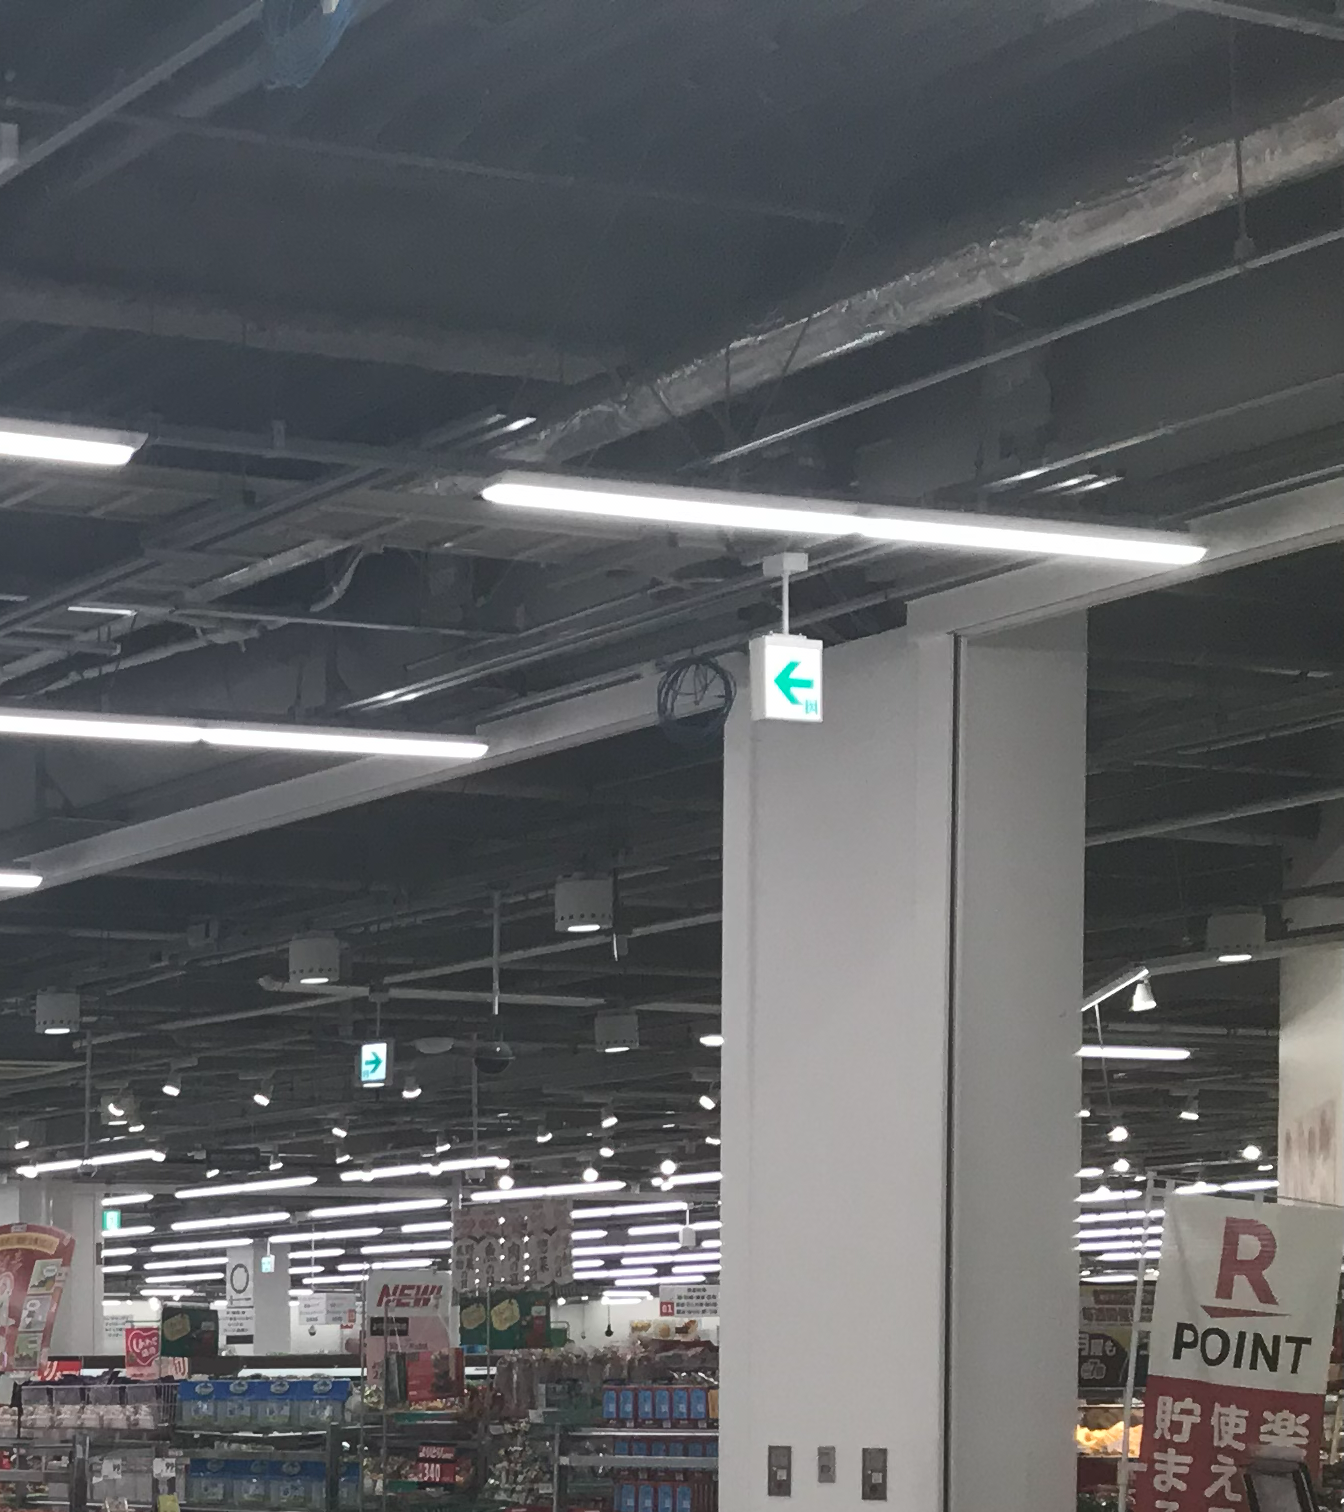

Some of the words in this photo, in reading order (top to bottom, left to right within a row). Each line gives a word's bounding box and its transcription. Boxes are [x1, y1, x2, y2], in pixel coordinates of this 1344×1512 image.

[1215, 1216, 1280, 1306] R
[376, 1283, 444, 1310] NEW!
[1172, 1321, 1313, 1375] POINT
